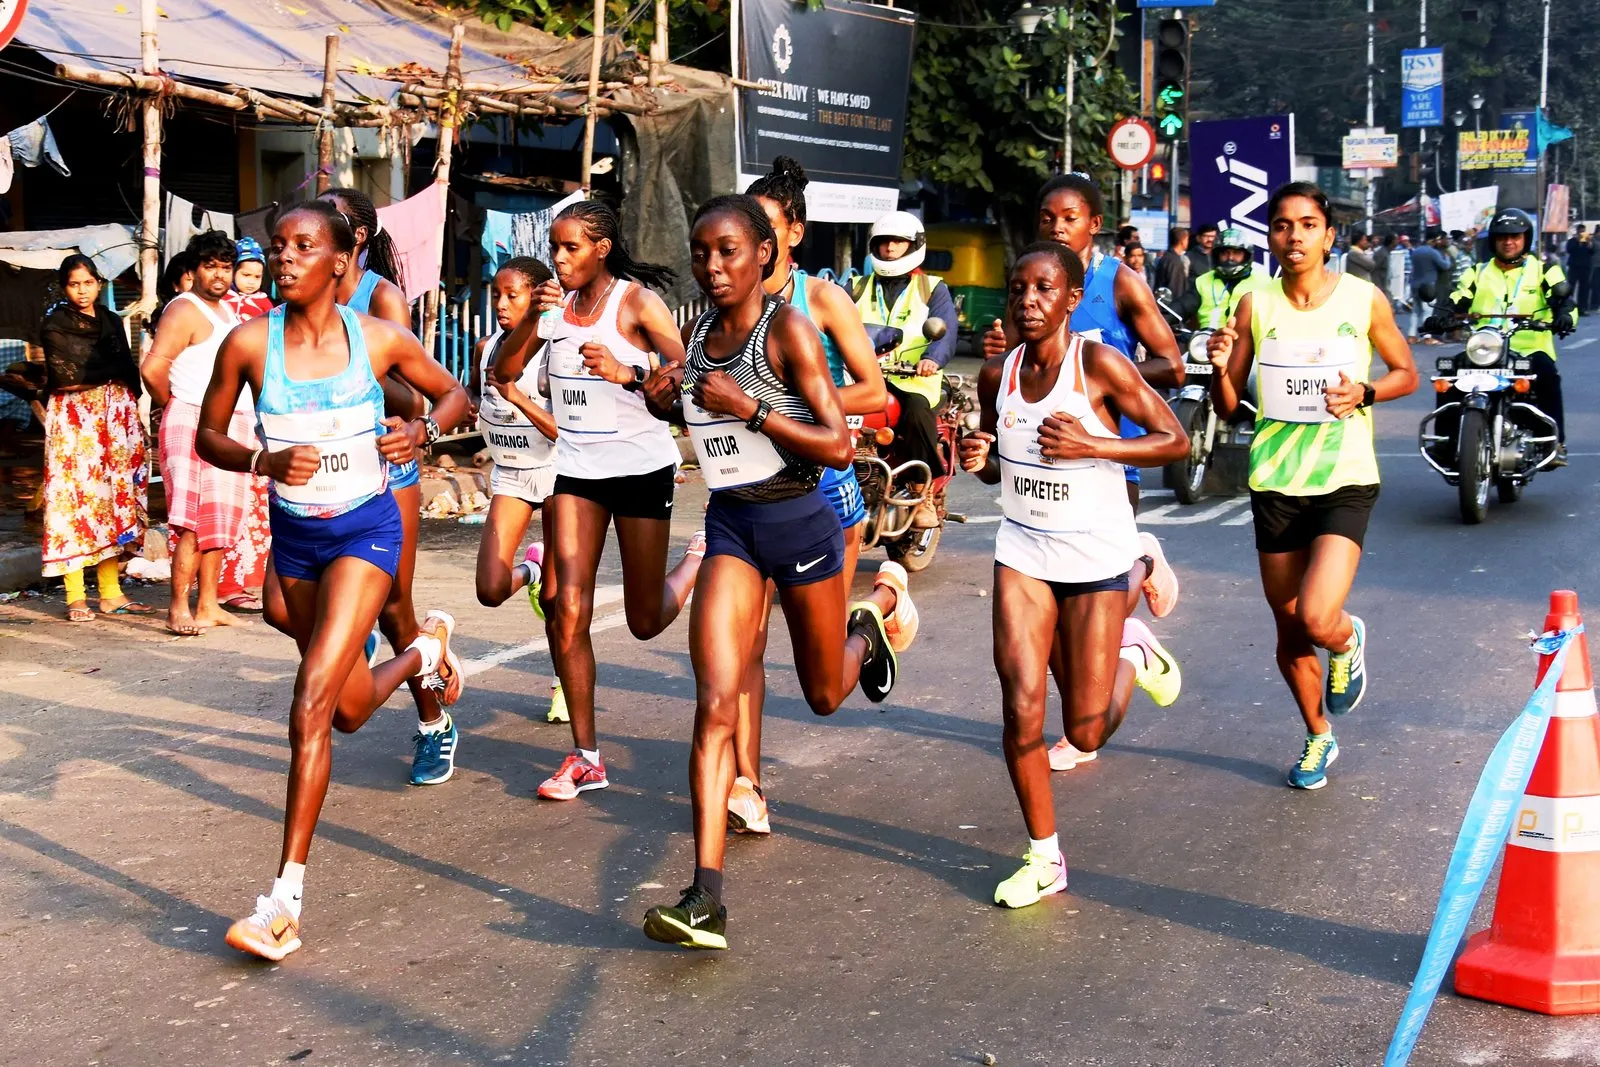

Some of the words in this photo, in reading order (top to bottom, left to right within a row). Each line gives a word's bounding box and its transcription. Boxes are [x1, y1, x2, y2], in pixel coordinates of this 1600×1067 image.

[783, 82, 808, 102] PRIVY
[817, 89, 830, 104] WE
[830, 91, 849, 107] HAVE
[849, 94, 871, 109] SAVED
[1410, 93, 1432, 102] YOU
[1407, 110, 1435, 120] HERE
[1410, 101, 1432, 110] ARE
[818, 109, 832, 124] THE
[834, 111, 849, 127] BEST
[850, 113, 864, 128] FOR
[865, 114, 877, 130] THE
[1286, 378, 1328, 396] SURIYA
[562, 389, 587, 406] KUMA
[488, 430, 530, 449] MATANGA
[703, 435, 740, 458] KITUR
[1013, 475, 1070, 502] KIPKETER
